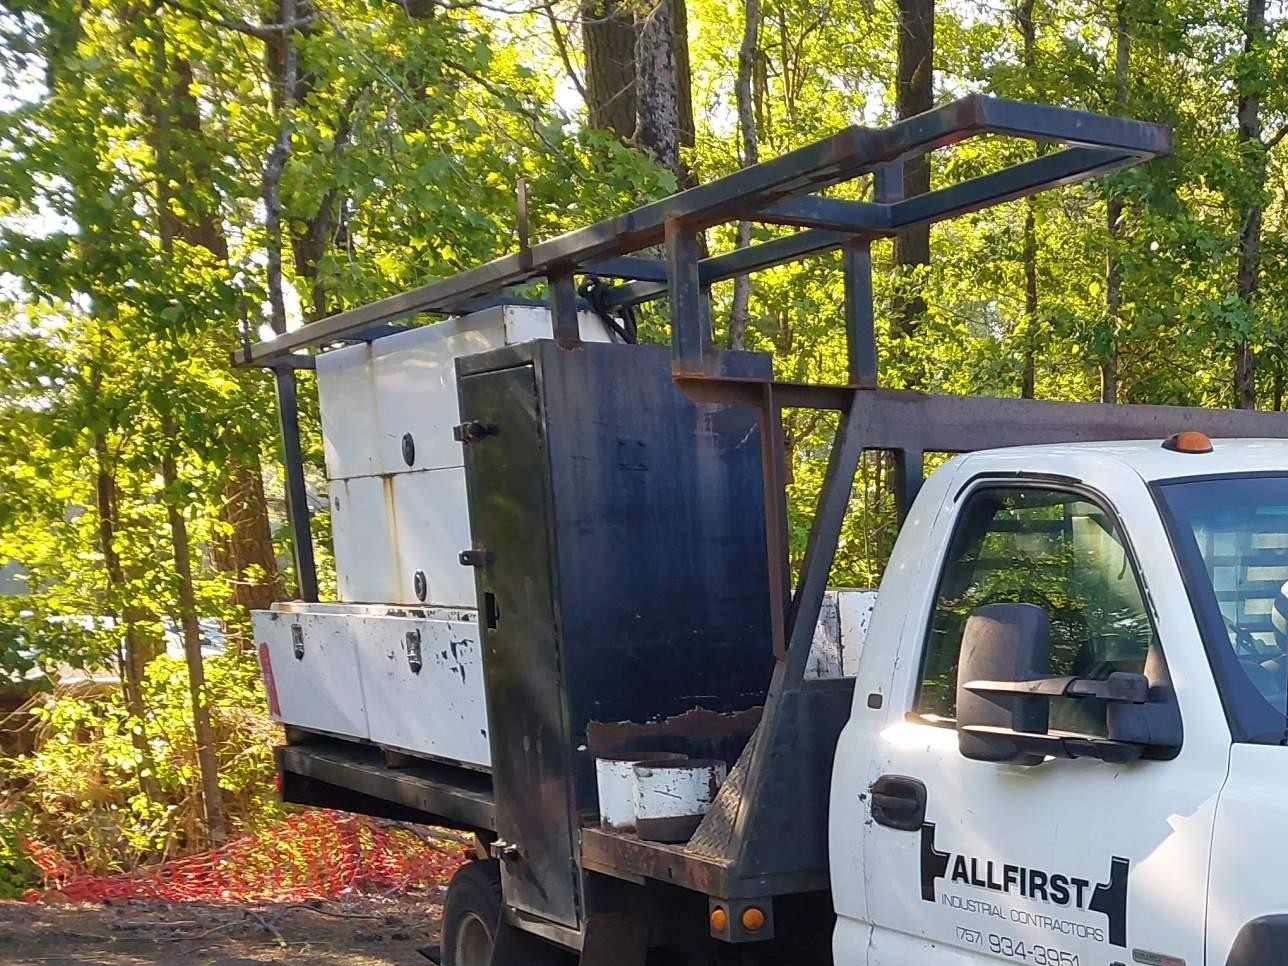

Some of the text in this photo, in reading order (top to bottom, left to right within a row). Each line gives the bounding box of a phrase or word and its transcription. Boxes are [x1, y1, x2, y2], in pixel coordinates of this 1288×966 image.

[951, 854, 1089, 908] ALLFIRST
[941, 893, 1104, 942] INDUSTRIAL CONTRACTORS
[956, 926, 983, 946] (757)
